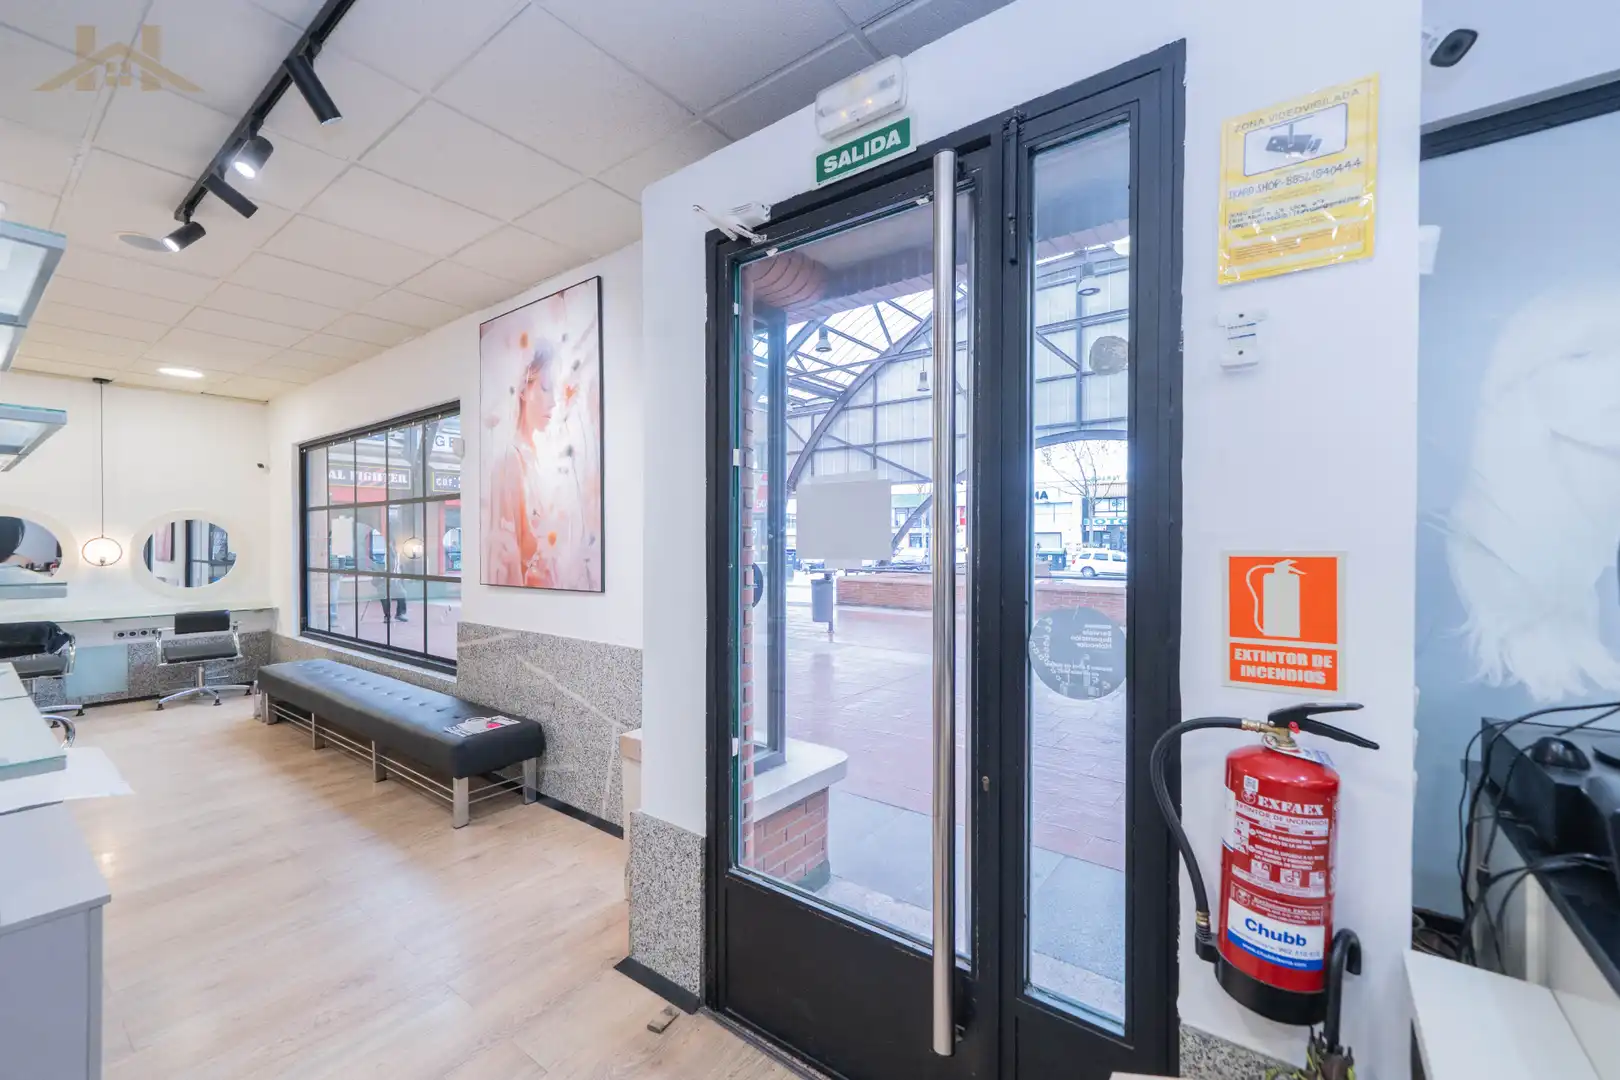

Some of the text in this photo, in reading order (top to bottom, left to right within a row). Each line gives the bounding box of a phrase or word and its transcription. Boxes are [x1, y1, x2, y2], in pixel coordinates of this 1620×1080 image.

[1233, 117, 1265, 134] ZONA
[823, 129, 902, 174] SALIDA
[1234, 648, 1333, 668] EXTINTOR DE
[1240, 664, 1326, 685] INCENDIOS
[1258, 795, 1324, 816] EXFAEX
[1244, 917, 1307, 947] Chubb
